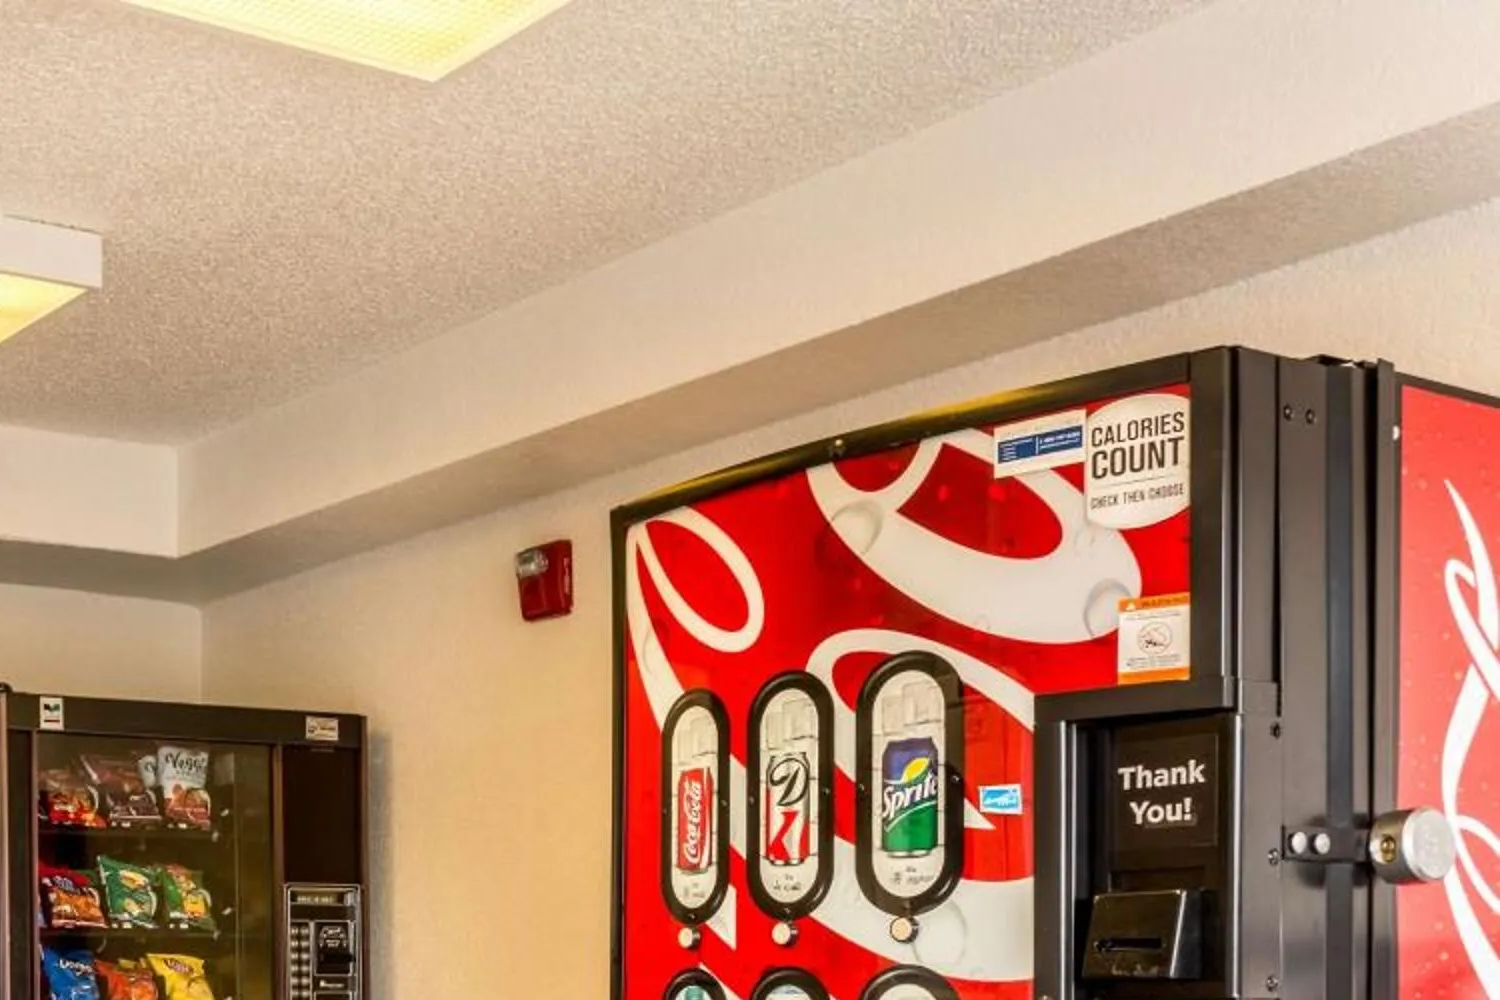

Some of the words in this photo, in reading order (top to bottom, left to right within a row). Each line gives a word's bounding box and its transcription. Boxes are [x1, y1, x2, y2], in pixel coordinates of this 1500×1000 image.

[1091, 411, 1185, 448] CALORIES
[1091, 436, 1185, 480] COUNT
[1091, 492, 1119, 510] CHECK
[1123, 488, 1145, 504] THEN
[1148, 482, 1184, 500] CHOOSE
[1118, 759, 1206, 790] Thank
[1130, 797, 1193, 825] You!
